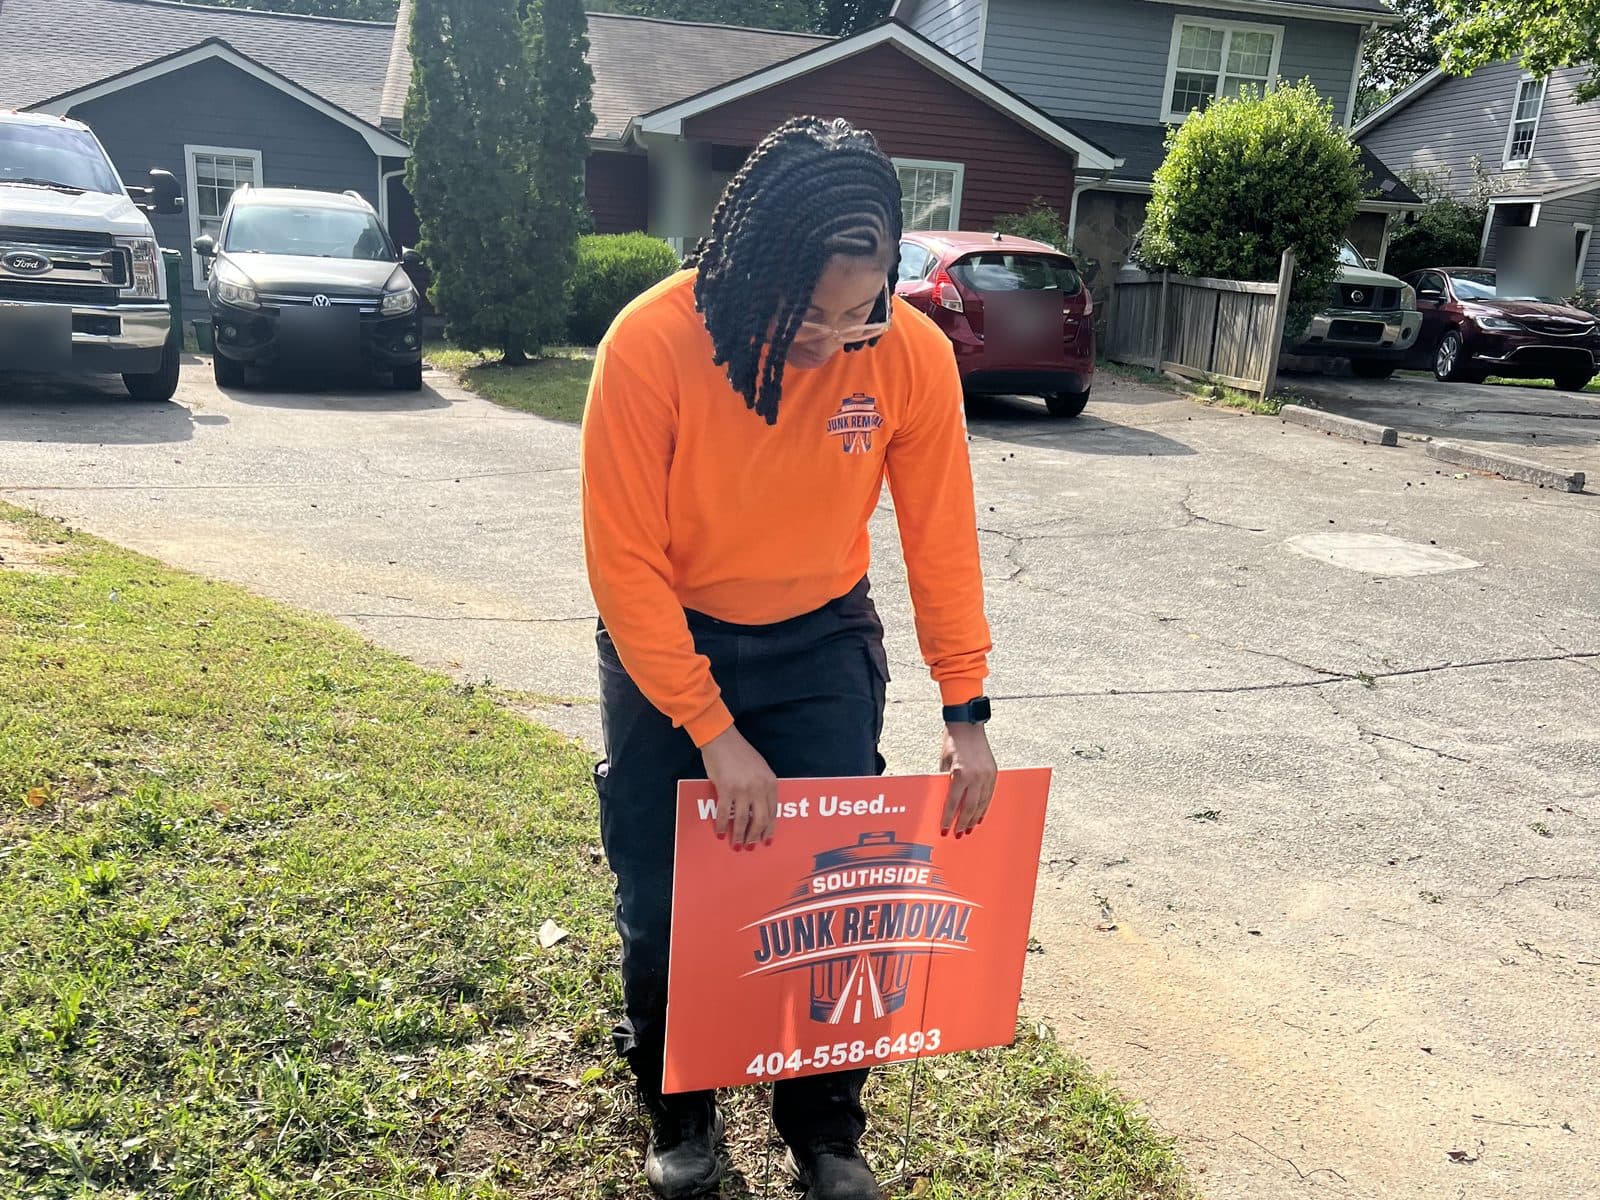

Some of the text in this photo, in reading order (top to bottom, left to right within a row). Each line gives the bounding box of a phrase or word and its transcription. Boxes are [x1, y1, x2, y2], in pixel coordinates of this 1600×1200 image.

[12, 256, 39, 269] Ford
[827, 416, 849, 432] JUNK
[818, 794, 906, 816] Used...
[812, 867, 930, 894] SOUTHSIDE
[754, 902, 972, 964] JUNK REMOVAL
[746, 1028, 942, 1077] 404-558-6493
